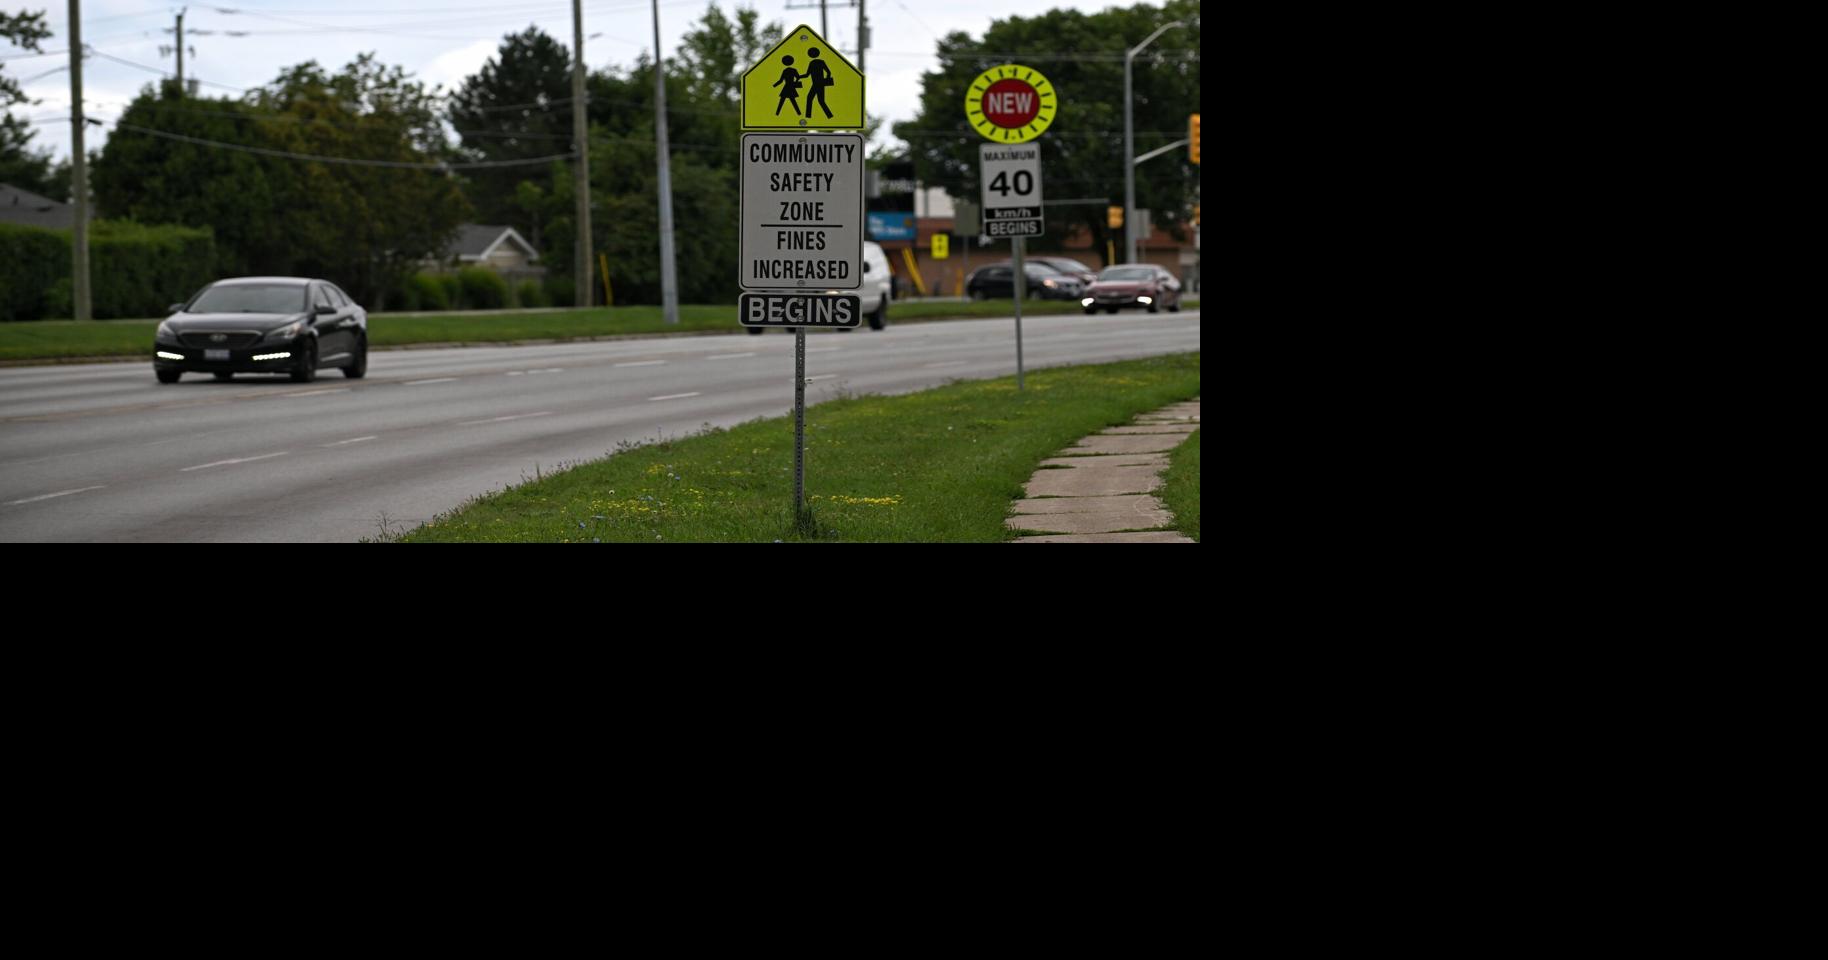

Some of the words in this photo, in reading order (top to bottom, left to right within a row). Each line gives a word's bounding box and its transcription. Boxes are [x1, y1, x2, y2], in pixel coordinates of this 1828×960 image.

[988, 92, 1033, 114] NEW
[750, 143, 855, 163] COMMUNITY
[984, 151, 1035, 162] MAXIMUM
[770, 172, 834, 192] SAFETY
[989, 170, 1033, 197] 40
[780, 202, 824, 221] ZONE
[994, 208, 1031, 219] km/h
[990, 221, 1037, 235] BEGINS
[777, 231, 826, 250] FINES
[753, 260, 849, 279] INCREASED
[748, 297, 851, 324] BEGINS
